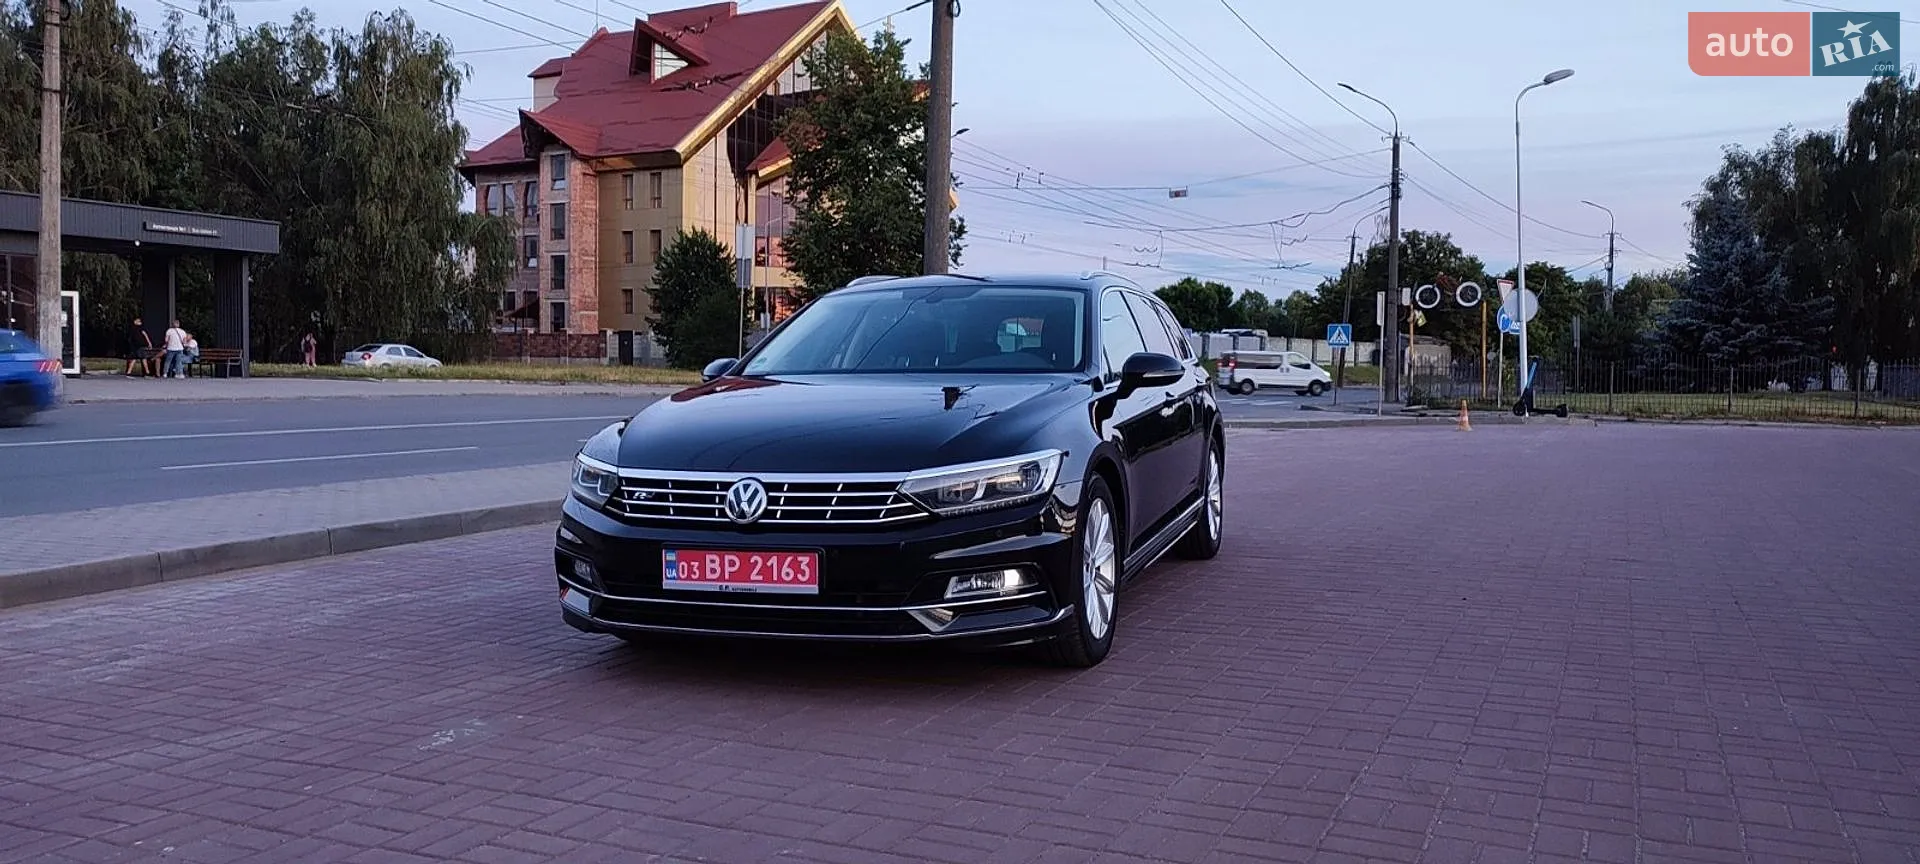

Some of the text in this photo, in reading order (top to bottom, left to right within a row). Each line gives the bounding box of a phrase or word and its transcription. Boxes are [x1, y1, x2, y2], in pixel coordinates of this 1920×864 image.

[666, 554, 811, 582] UA 03 BP 2163
